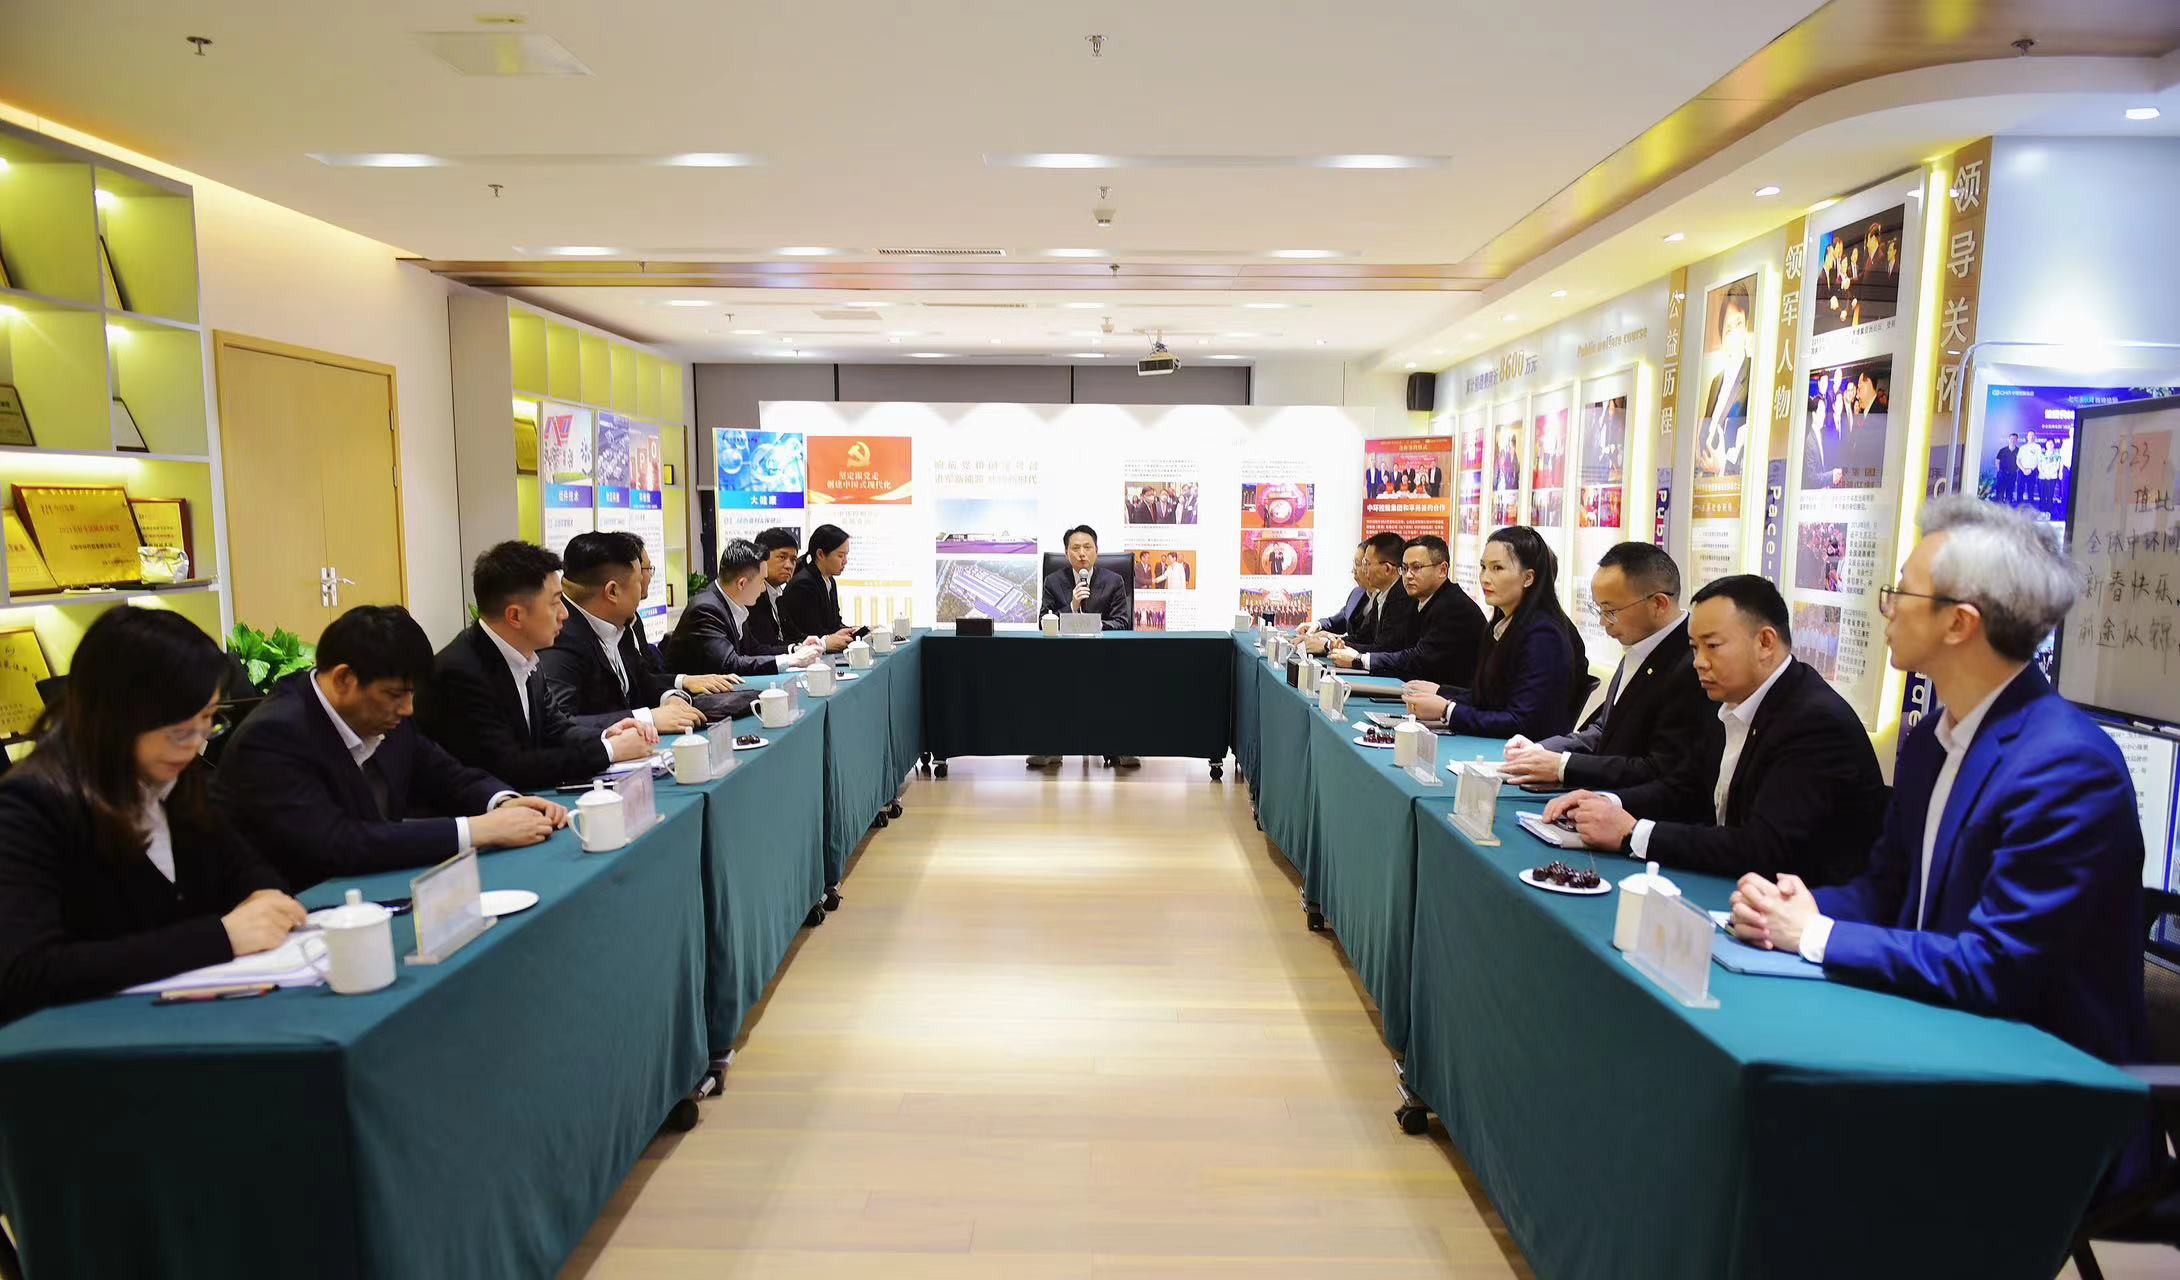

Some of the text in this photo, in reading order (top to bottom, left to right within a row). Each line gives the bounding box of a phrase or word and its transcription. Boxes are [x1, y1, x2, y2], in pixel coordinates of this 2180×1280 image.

[1937, 160, 1984, 413] 领导关怀
[1623, 327, 1648, 345] course
[1774, 243, 1804, 420] 领军人物
[1499, 351, 1525, 384] 8600
[1661, 290, 1680, 435] 公益历程
[2106, 441, 2151, 474] 2023
[750, 495, 778, 506] 大健康
[1655, 490, 1667, 547] Publ
[1765, 485, 1782, 583] Pace-s
